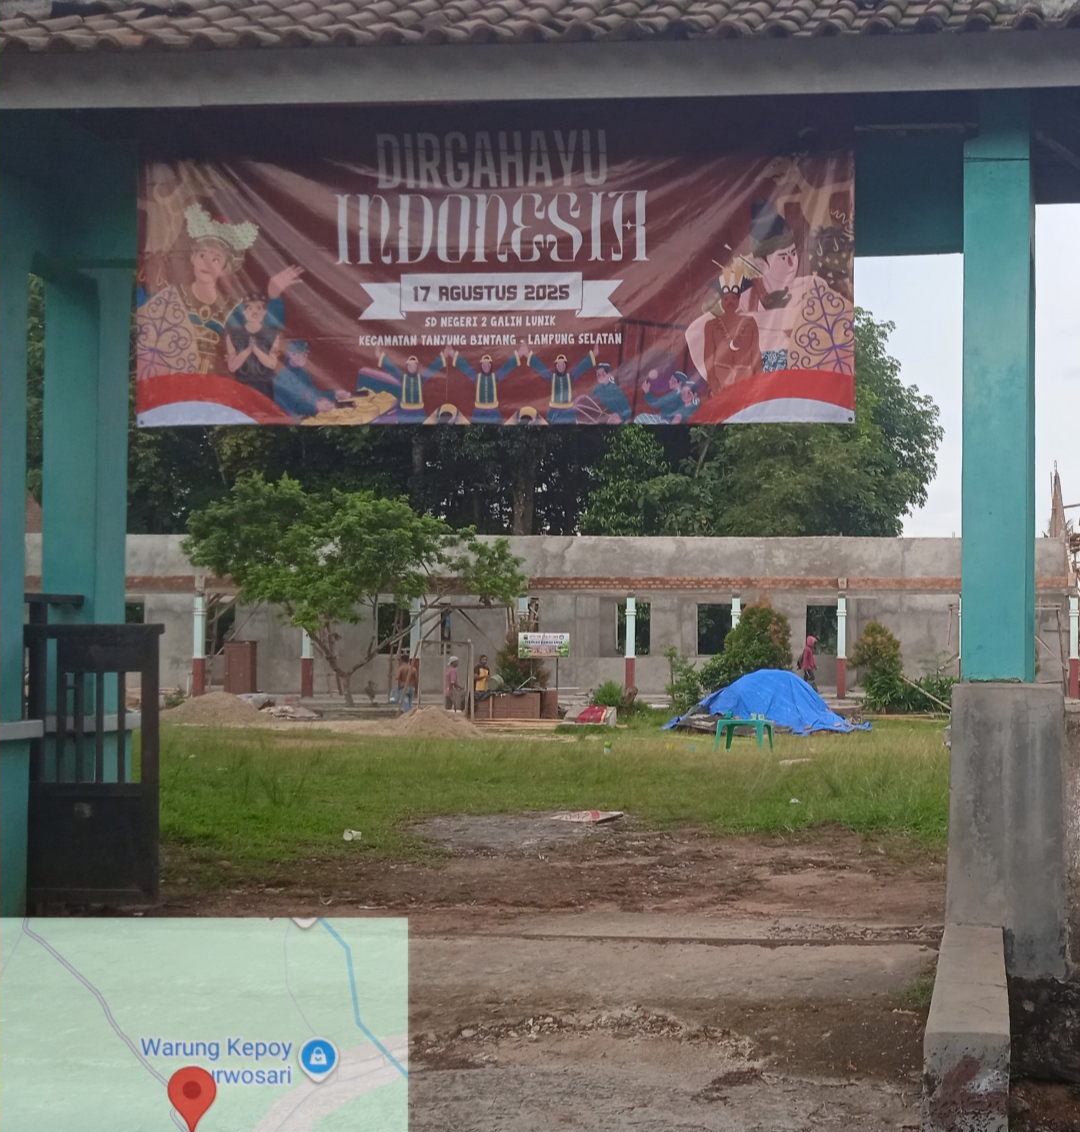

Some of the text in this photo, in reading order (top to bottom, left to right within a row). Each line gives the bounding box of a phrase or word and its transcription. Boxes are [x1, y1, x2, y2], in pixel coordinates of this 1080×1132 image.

[376, 129, 607, 189] DIRGAHAYU
[335, 190, 650, 264] INDONESIA
[413, 284, 570, 302] 17 AGUSTUS 2025
[425, 315, 555, 327] SD NEGERI 2 GALIH LUNIK
[359, 335, 417, 346] KECAMATAN
[421, 335, 467, 346] TANJUNG
[470, 334, 516, 345] BINTANG
[528, 334, 574, 345] LAMPUNG
[579, 333, 621, 345] SELATAN
